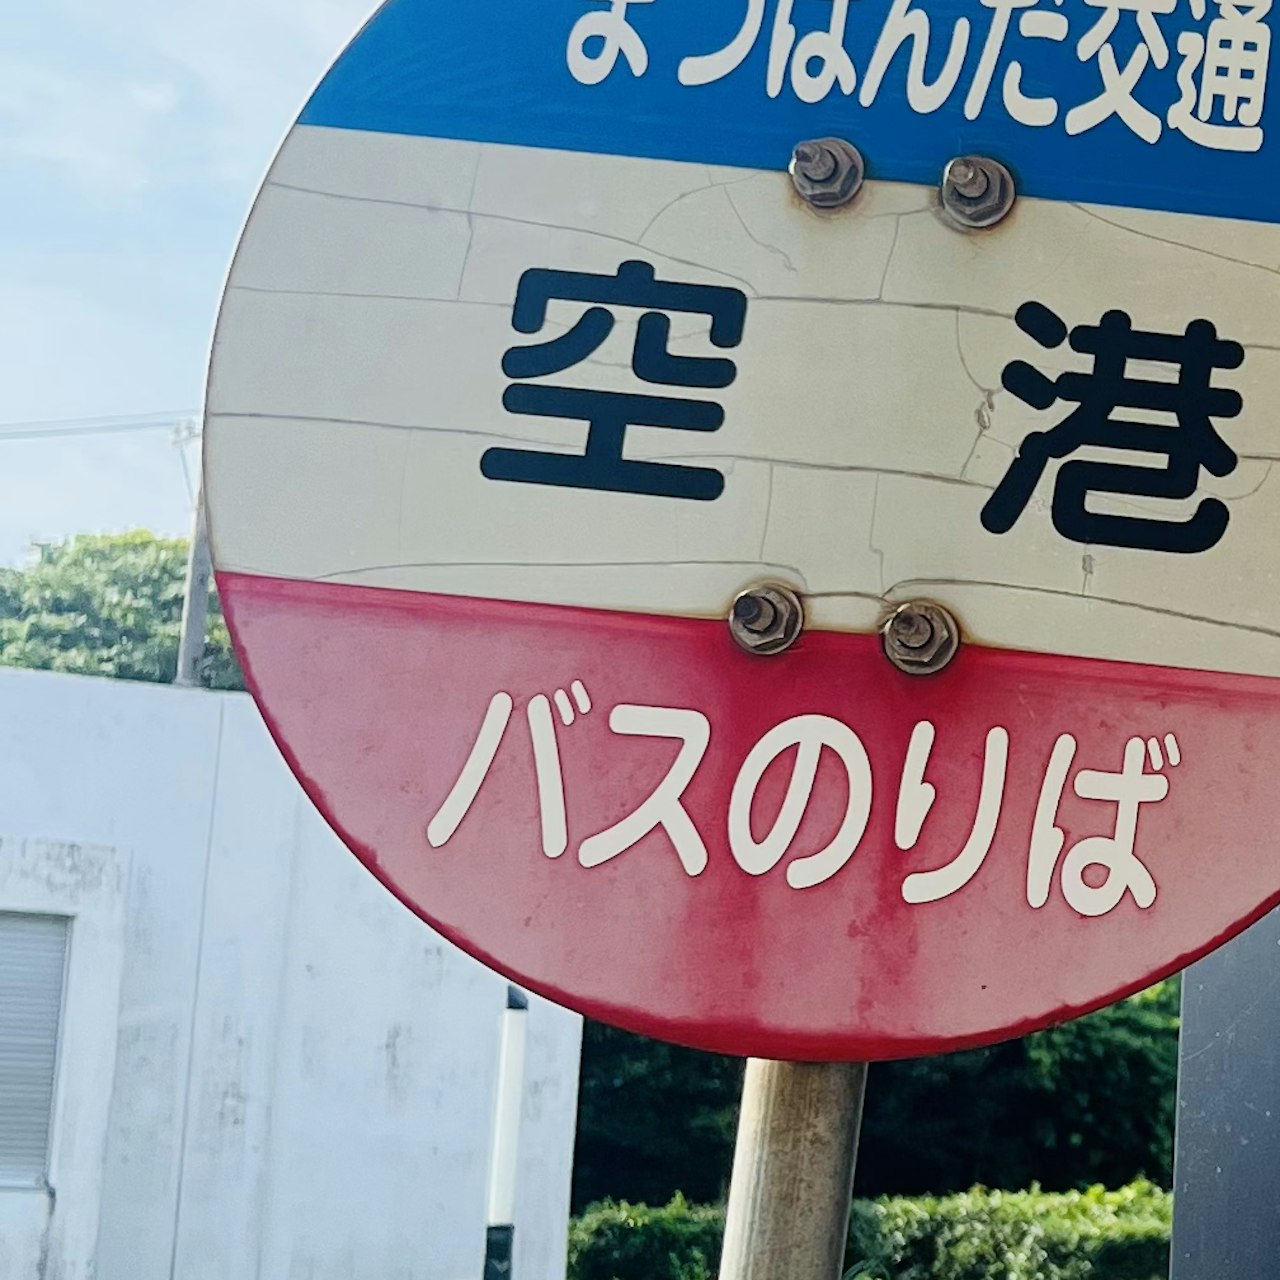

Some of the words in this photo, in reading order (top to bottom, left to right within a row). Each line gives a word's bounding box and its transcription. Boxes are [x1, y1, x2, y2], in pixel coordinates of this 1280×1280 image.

[427, 678, 1182, 916] バスのりば
